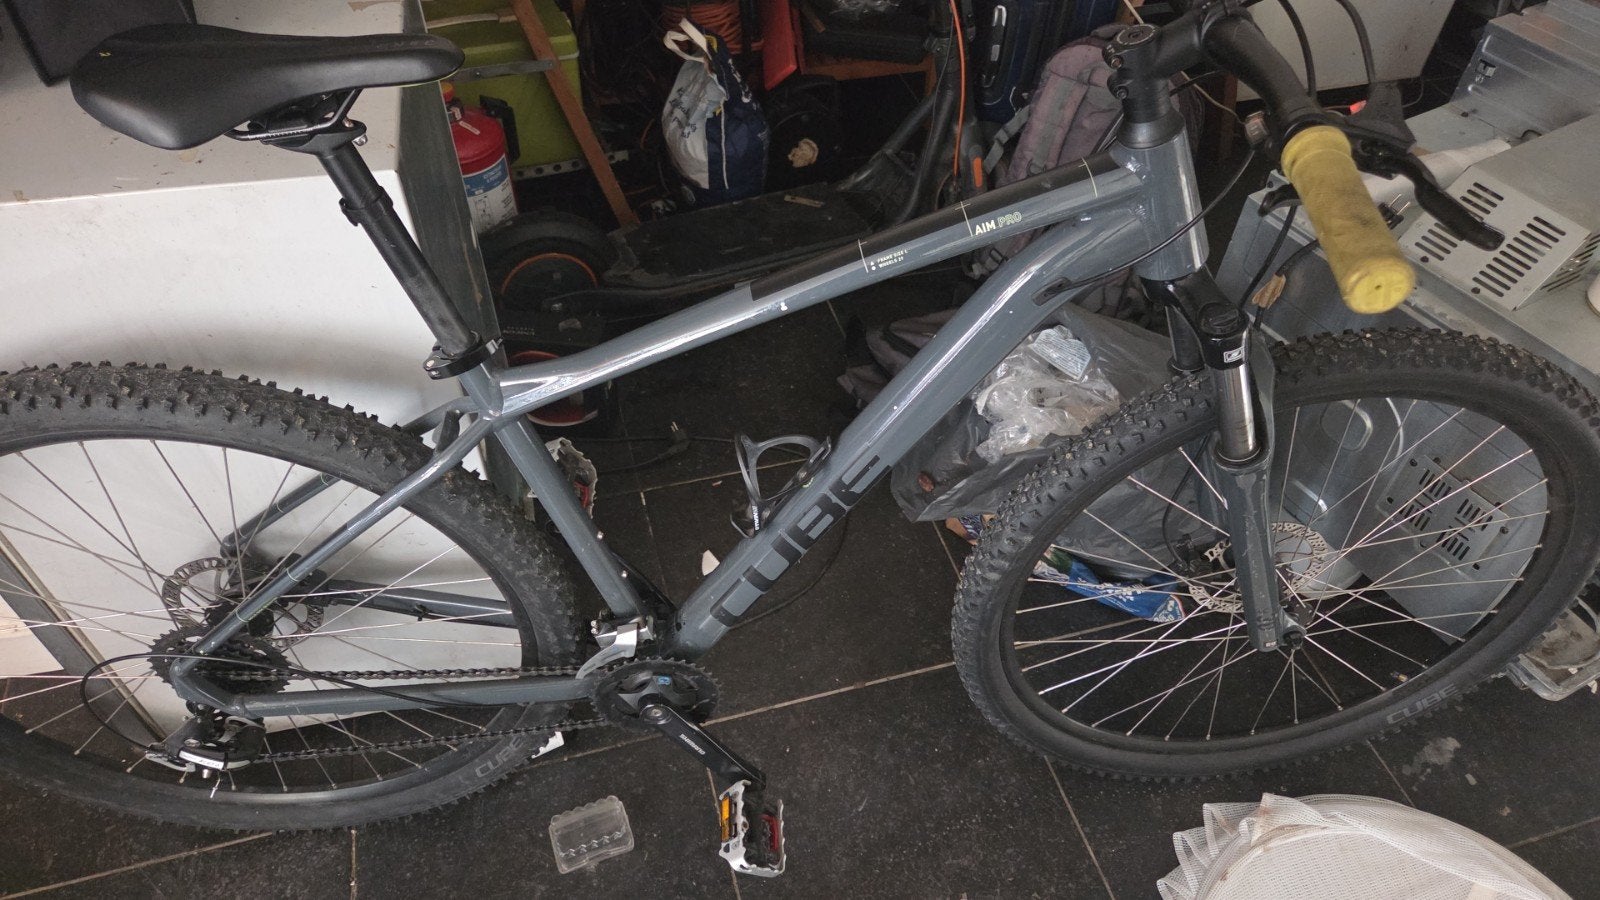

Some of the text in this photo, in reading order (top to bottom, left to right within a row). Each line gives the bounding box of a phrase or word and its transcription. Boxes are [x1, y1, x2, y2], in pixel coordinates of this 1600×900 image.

[975, 211, 1022, 236] AIM PRO
[710, 455, 893, 627] CUBE
[1386, 683, 1458, 725] CUBE
[475, 736, 524, 778] CUBE
[679, 733, 706, 755] SHIMANO
